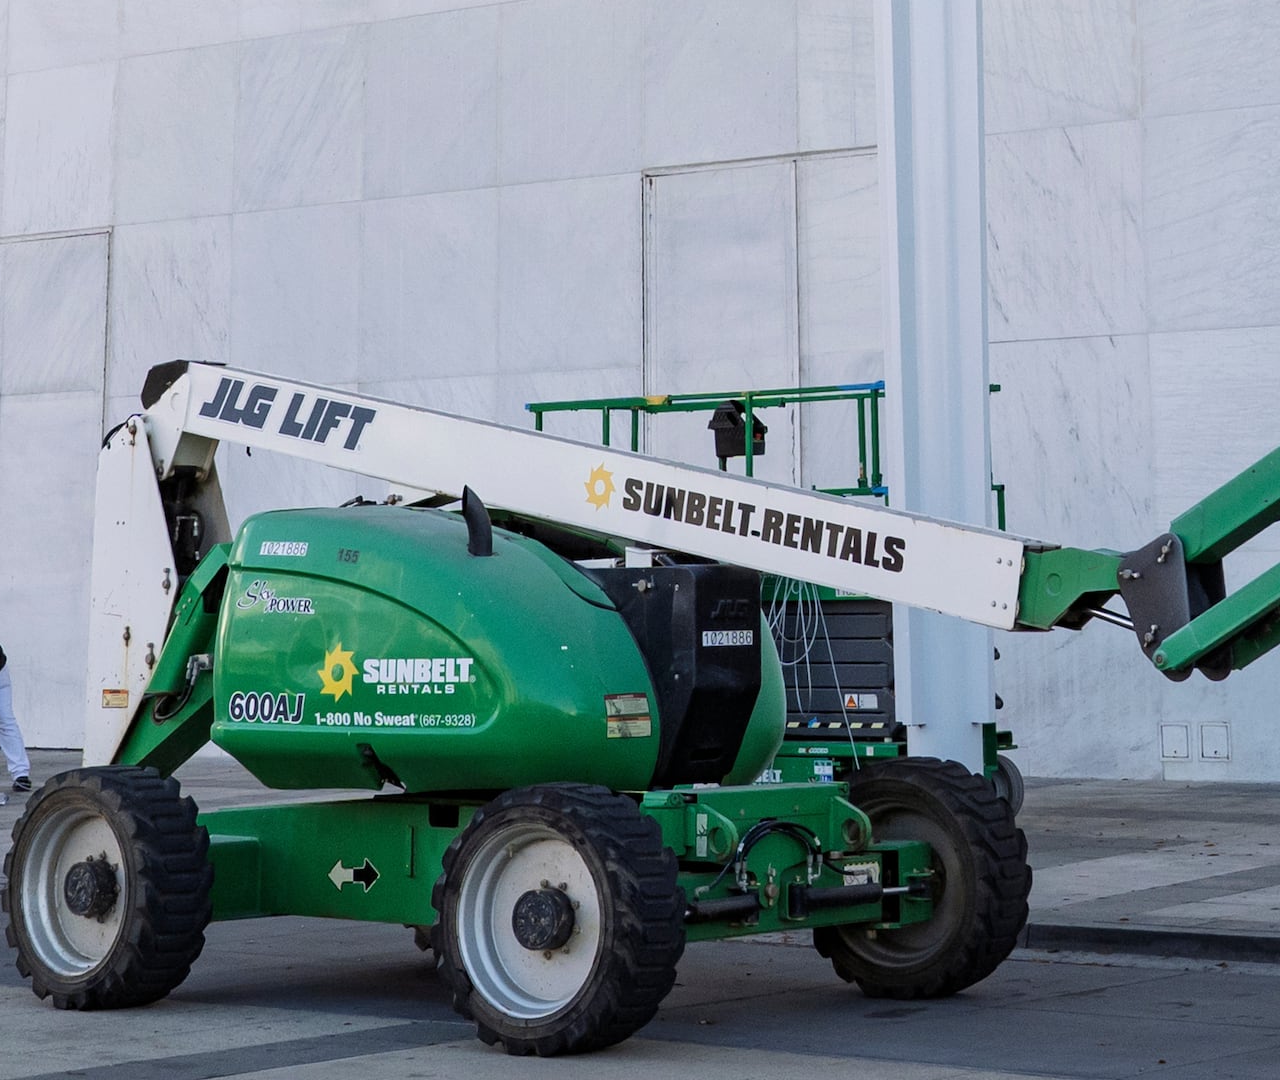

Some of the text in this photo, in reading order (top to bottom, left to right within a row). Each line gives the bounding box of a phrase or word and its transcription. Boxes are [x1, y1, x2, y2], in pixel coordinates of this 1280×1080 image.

[199, 377, 377, 451] JLG LIFT
[261, 542, 307, 556] 1021886
[266, 598, 312, 614] POWER
[703, 631, 752, 645] 1021886
[376, 684, 455, 694] RENTALS
[229, 691, 306, 724] 600AJ
[314, 712, 351, 726] 1-800
[353, 711, 372, 726] No
[419, 713, 476, 728] (667-9328)
